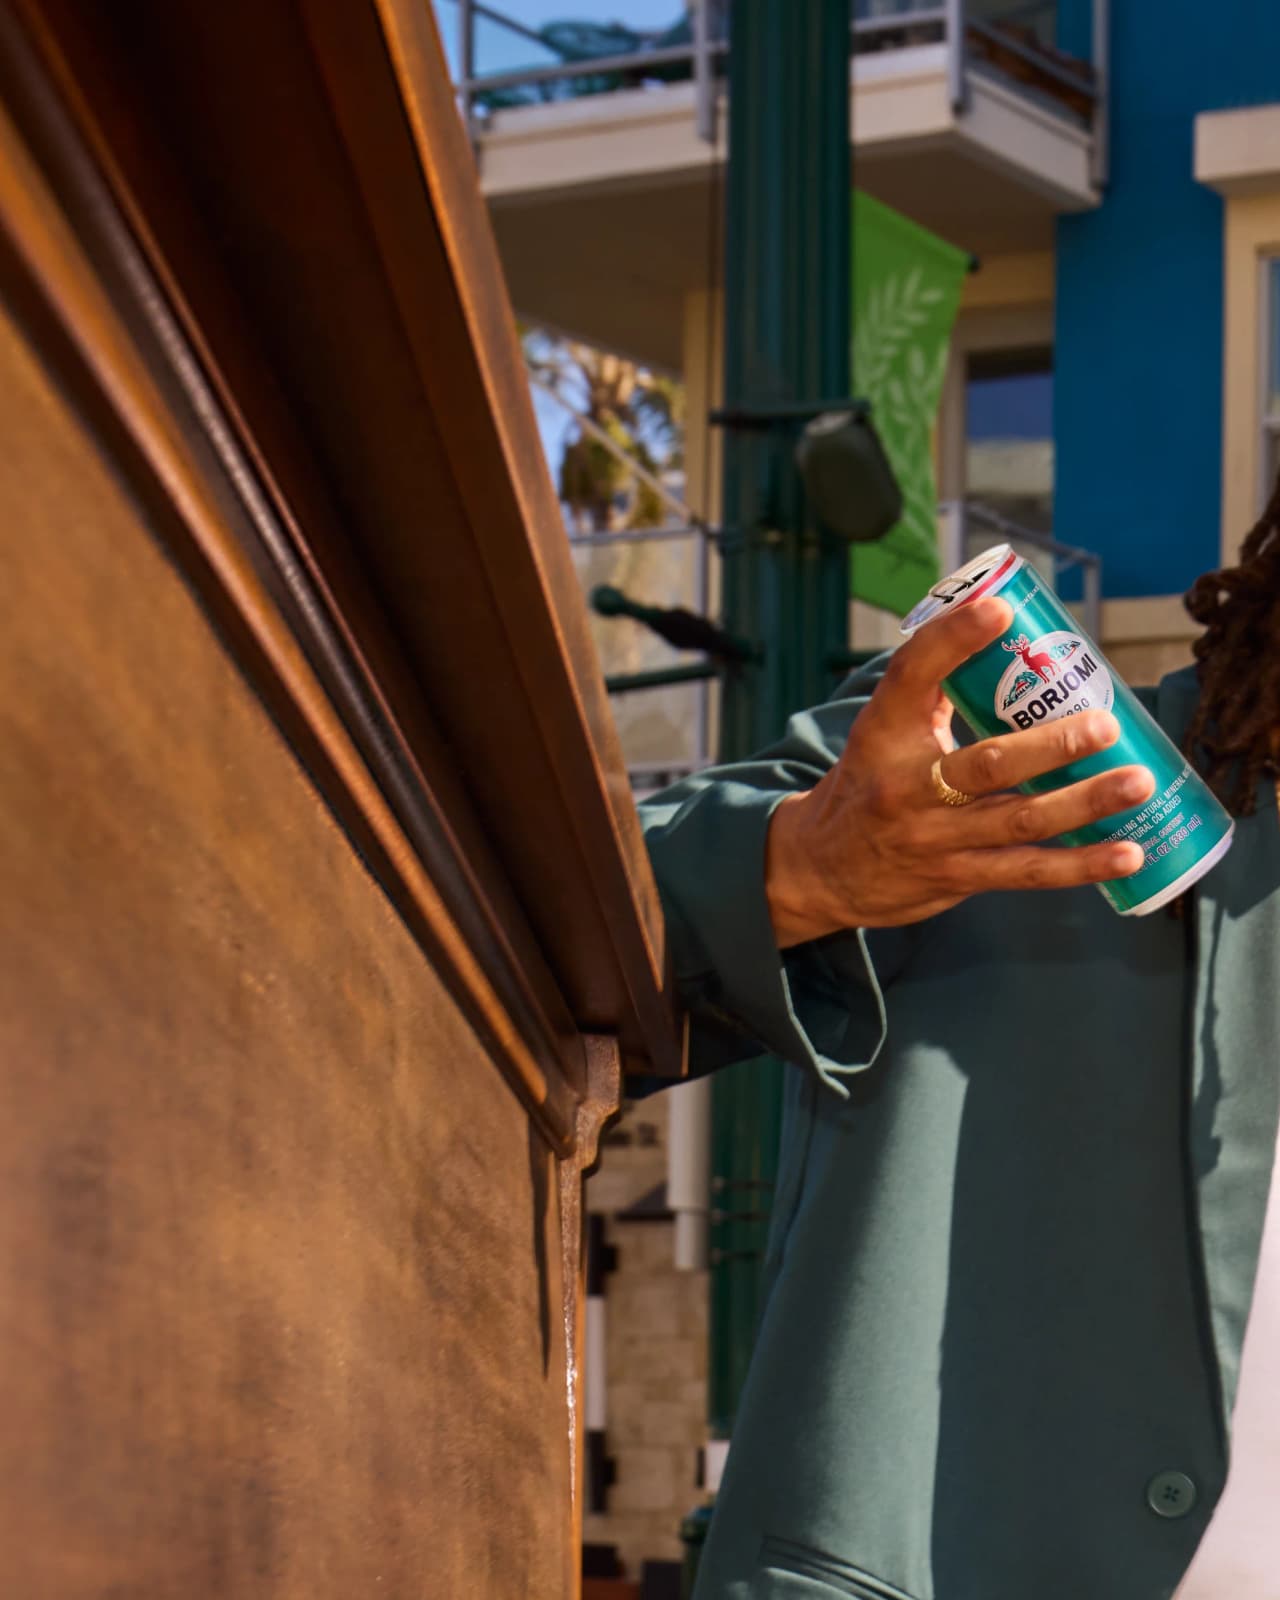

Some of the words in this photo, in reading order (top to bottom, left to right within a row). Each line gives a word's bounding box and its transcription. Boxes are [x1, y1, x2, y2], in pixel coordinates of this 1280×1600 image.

[1012, 653, 1098, 730] BORJOMI
[1136, 797, 1166, 824] NATURAL
[1163, 775, 1186, 799] MINERAL
[1162, 794, 1182, 816] ADDED
[1156, 841, 1171, 857] OZ
